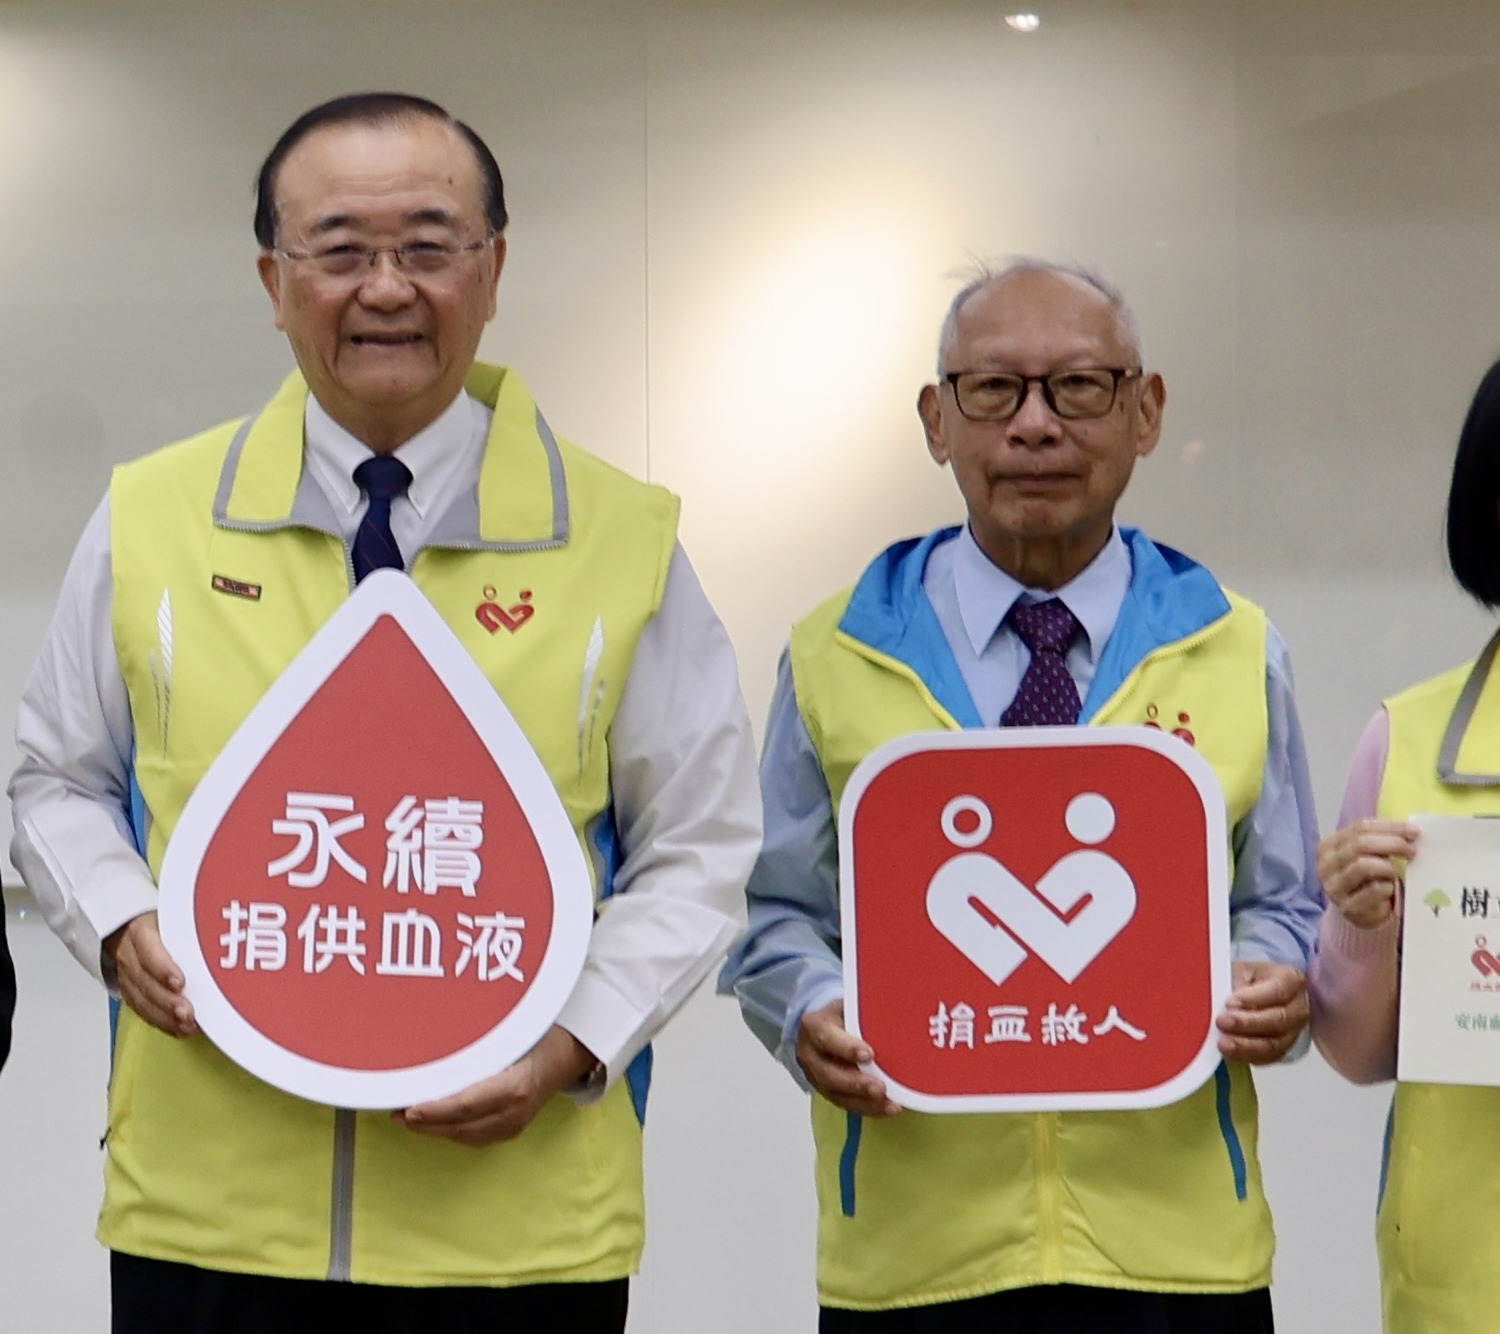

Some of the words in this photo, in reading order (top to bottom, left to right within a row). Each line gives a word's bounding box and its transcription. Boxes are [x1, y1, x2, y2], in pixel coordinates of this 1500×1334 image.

[267, 791, 484, 897] 永續
[219, 900, 525, 982] 捐供血液
[929, 1001, 1147, 1049] 捐血救人
